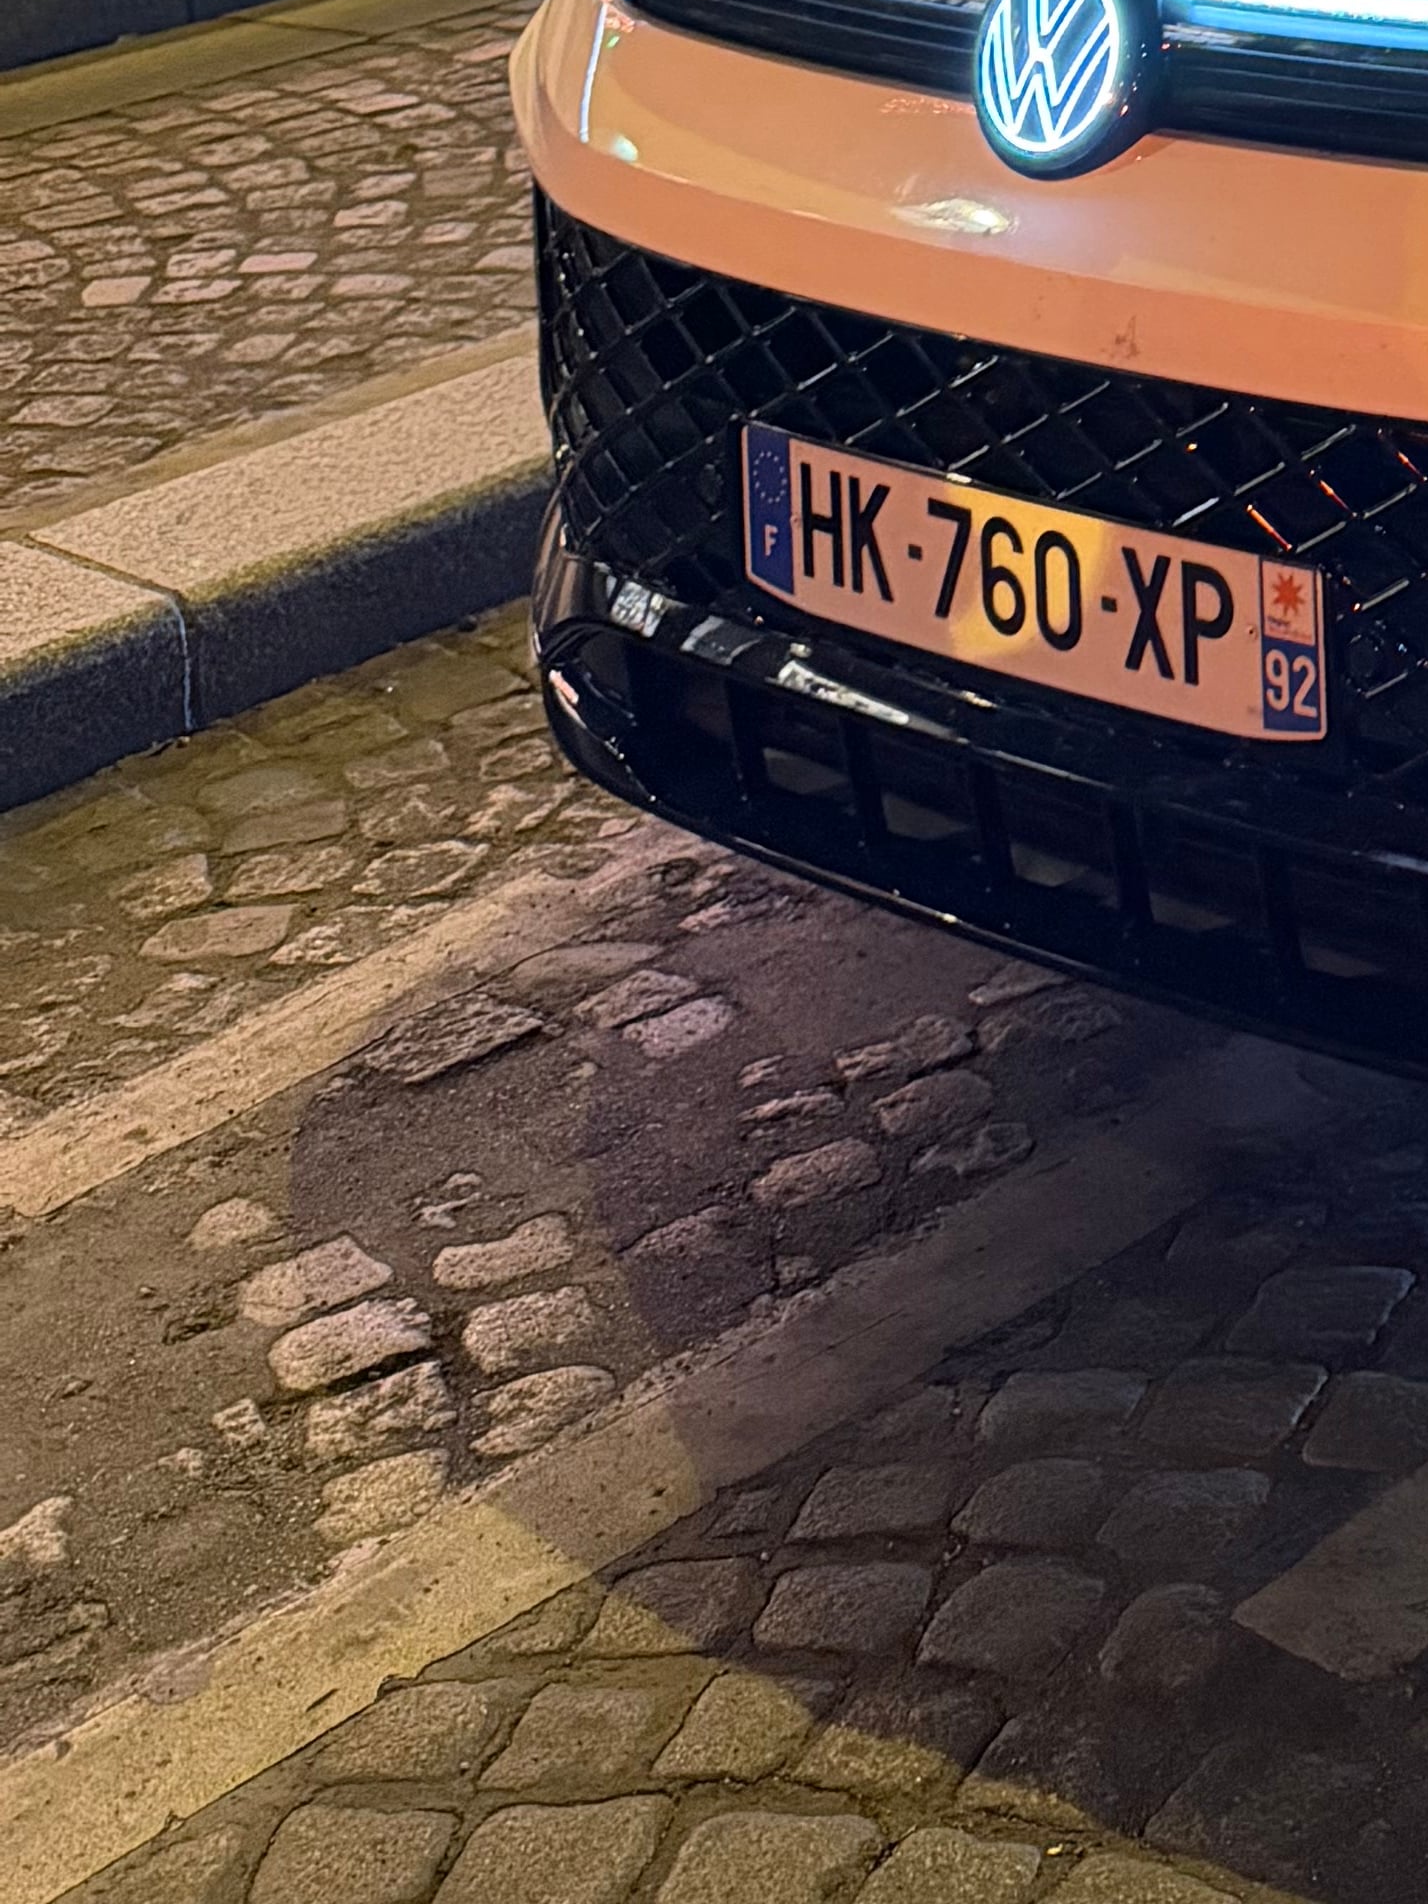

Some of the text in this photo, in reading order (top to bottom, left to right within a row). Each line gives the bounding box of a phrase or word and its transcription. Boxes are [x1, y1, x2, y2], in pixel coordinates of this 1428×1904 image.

[764, 524, 779, 557] F
[800, 461, 1235, 686] HK-760-XP
[1265, 649, 1319, 718] 92
